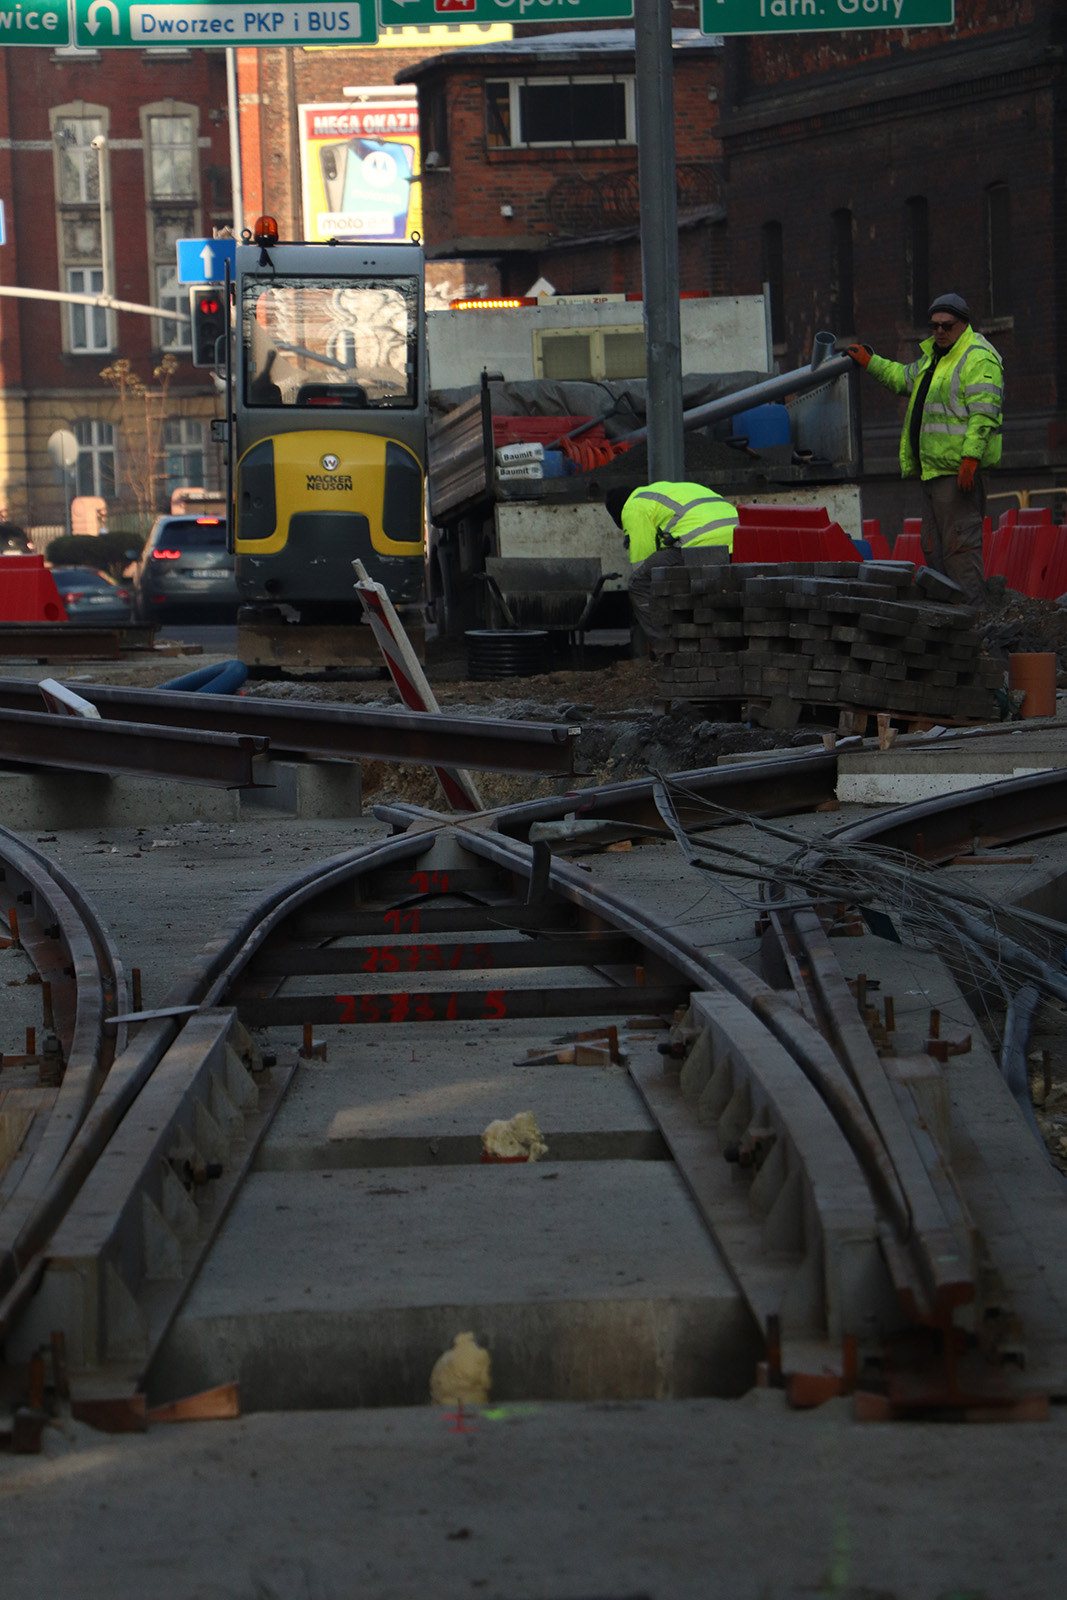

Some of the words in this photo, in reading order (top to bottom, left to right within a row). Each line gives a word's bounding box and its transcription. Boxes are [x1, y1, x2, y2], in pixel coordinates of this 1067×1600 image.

[141, 14, 234, 33] Dworzec
[244, 13, 284, 32] PKP
[294, 13, 299, 31] i
[308, 12, 350, 31] BUS
[314, 115, 359, 135] MEGA
[503, 450, 533, 461] Baumit
[500, 467, 529, 476] Baumit
[306, 475, 352, 483] WACKER
[306, 483, 353, 491] NEUSON
